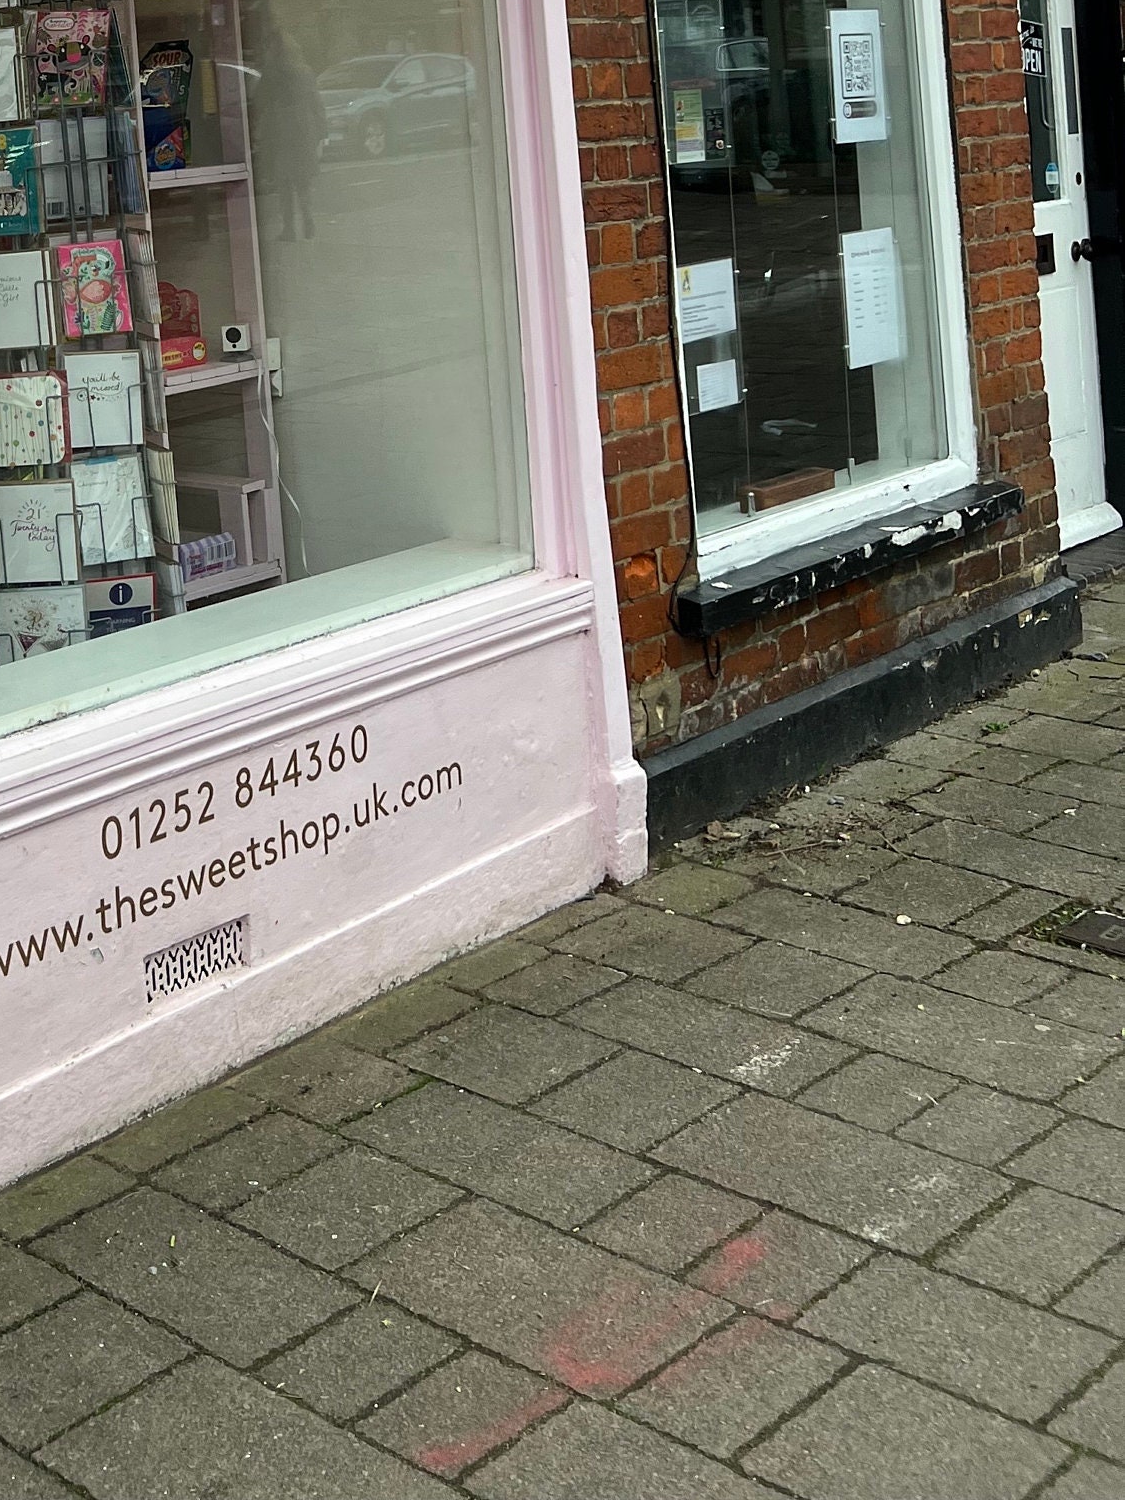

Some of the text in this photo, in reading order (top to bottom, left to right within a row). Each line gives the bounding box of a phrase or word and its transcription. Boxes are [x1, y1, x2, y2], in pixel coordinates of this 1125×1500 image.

[153, 51, 182, 67] SOUR
[1022, 47, 1042, 73] PEN
[26, 507, 42, 521] 21
[28, 532, 56, 552] today
[100, 723, 370, 861] 01252 844360
